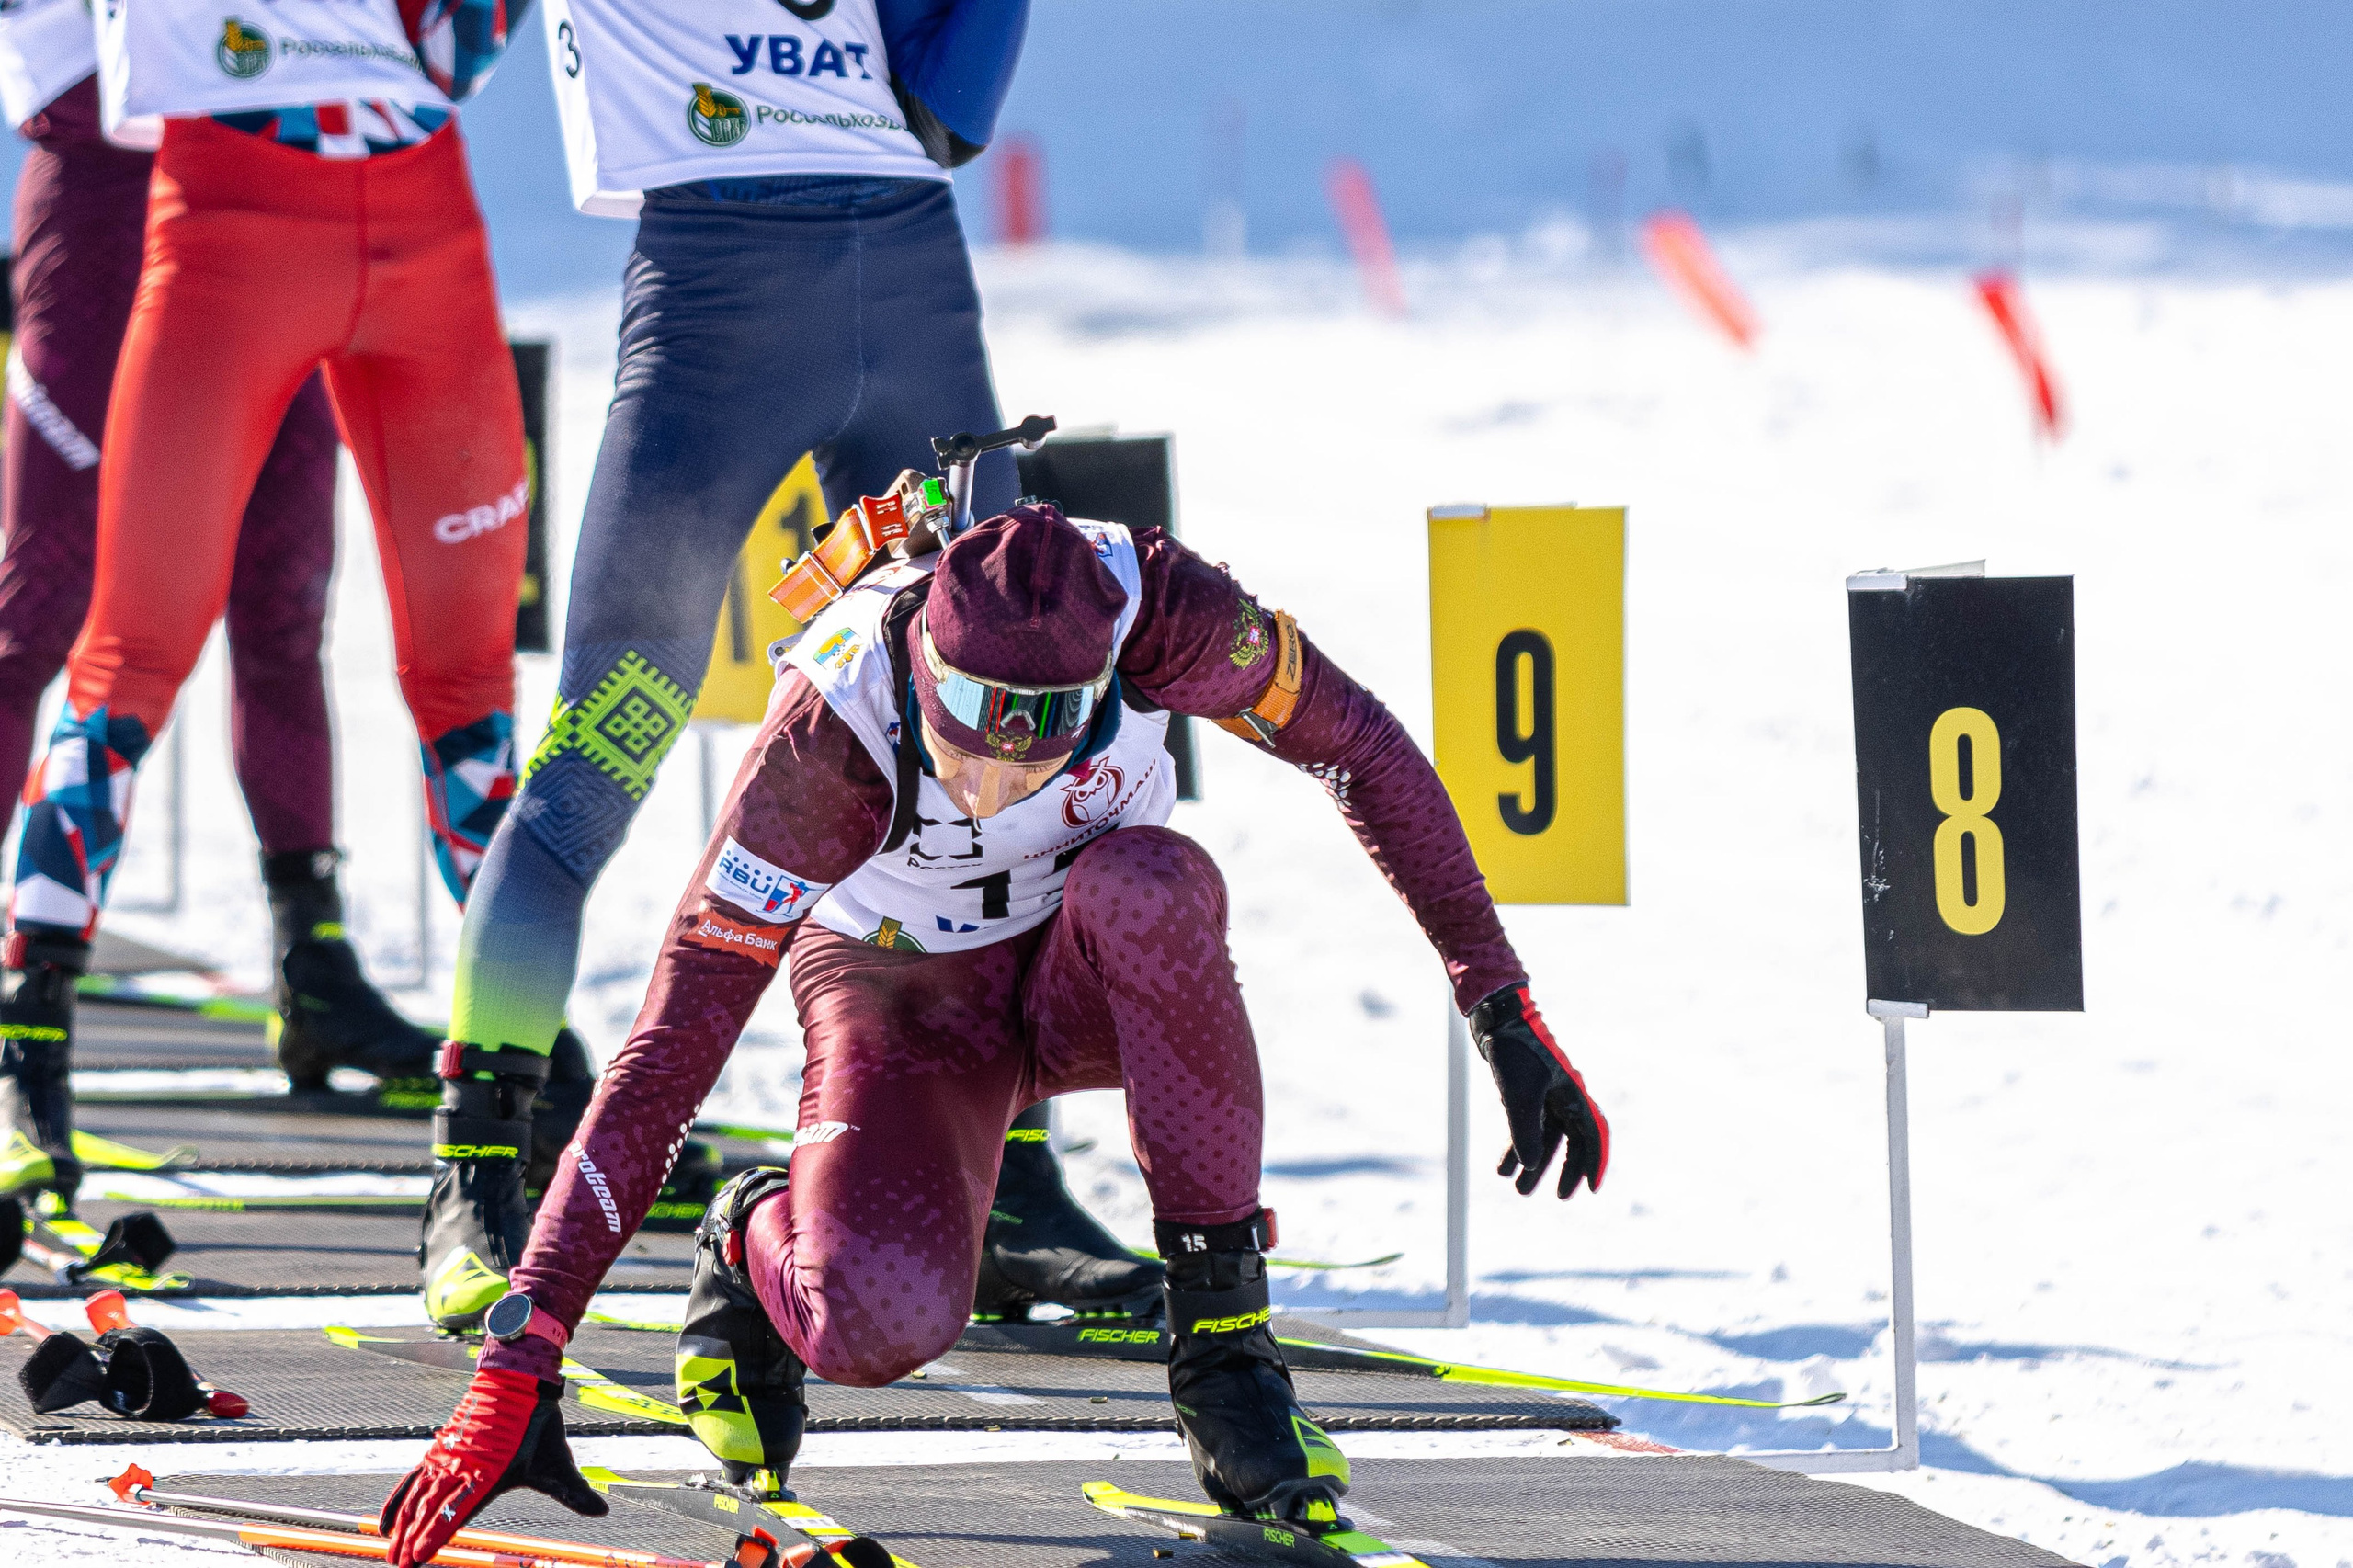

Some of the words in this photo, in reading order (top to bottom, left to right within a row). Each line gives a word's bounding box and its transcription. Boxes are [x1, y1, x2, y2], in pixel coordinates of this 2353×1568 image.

[725, 34, 873, 80] УВАТ
[1495, 627, 1558, 835] 9
[1929, 707, 2006, 936] 8
[719, 855, 771, 895] RBU
[699, 919, 743, 943] Альфа
[745, 933, 778, 951] Банк
[1180, 1233, 1208, 1253] 15
[1078, 1328, 1161, 1345] FISCHER
[1263, 1527, 1296, 1549] FISCHER
